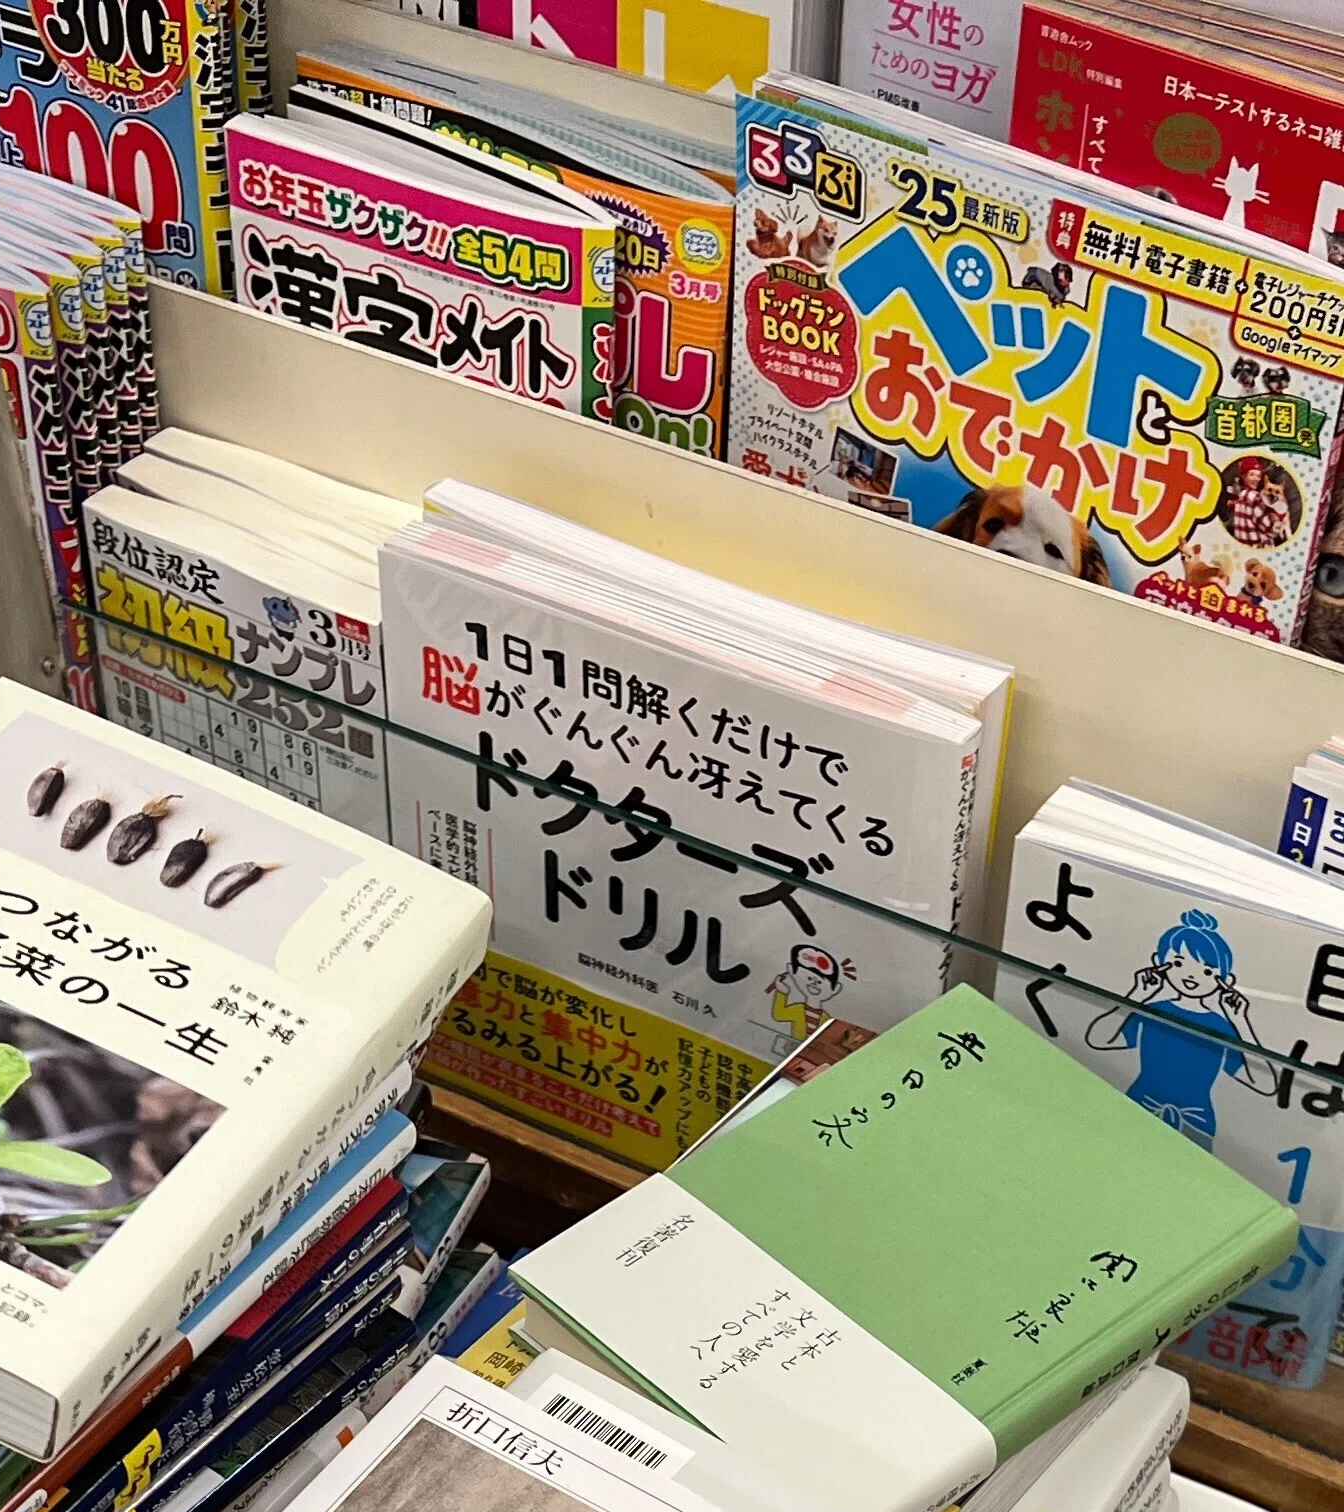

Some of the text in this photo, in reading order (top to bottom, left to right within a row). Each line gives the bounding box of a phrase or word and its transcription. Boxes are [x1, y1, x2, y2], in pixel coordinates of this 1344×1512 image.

[889, 0, 985, 49] 女性の
[87, 57, 145, 92] 当たる
[871, 40, 996, 104] ためのヨガ
[747, 126, 864, 218] るるぶ
[961, 197, 1022, 236] 最新版
[1056, 210, 1078, 250] 特典
[454, 228, 567, 288] 全54問
[668, 271, 721, 301] 3月号
[758, 287, 844, 325] ドッグラン
[763, 317, 841, 356] BOOK
[867, 329, 1206, 543] おでかけ
[92, 518, 223, 603] 段位認定
[234, 617, 378, 707] ナンプレ
[465, 621, 851, 788] 1日1問解くだけで
[421, 644, 895, 857] 脳がぐんぐん冴えてくる
[475, 730, 834, 936] ドクターズ
[543, 848, 750, 982] ドリル
[442, 1007, 667, 1114] るみる上がる!
[687, 1287, 793, 1363] すべての人へ
[696, 1306, 817, 1391] 文学を愛する
[779, 1325, 842, 1372] 古本と
[446, 1402, 563, 1476] 折口信夫
